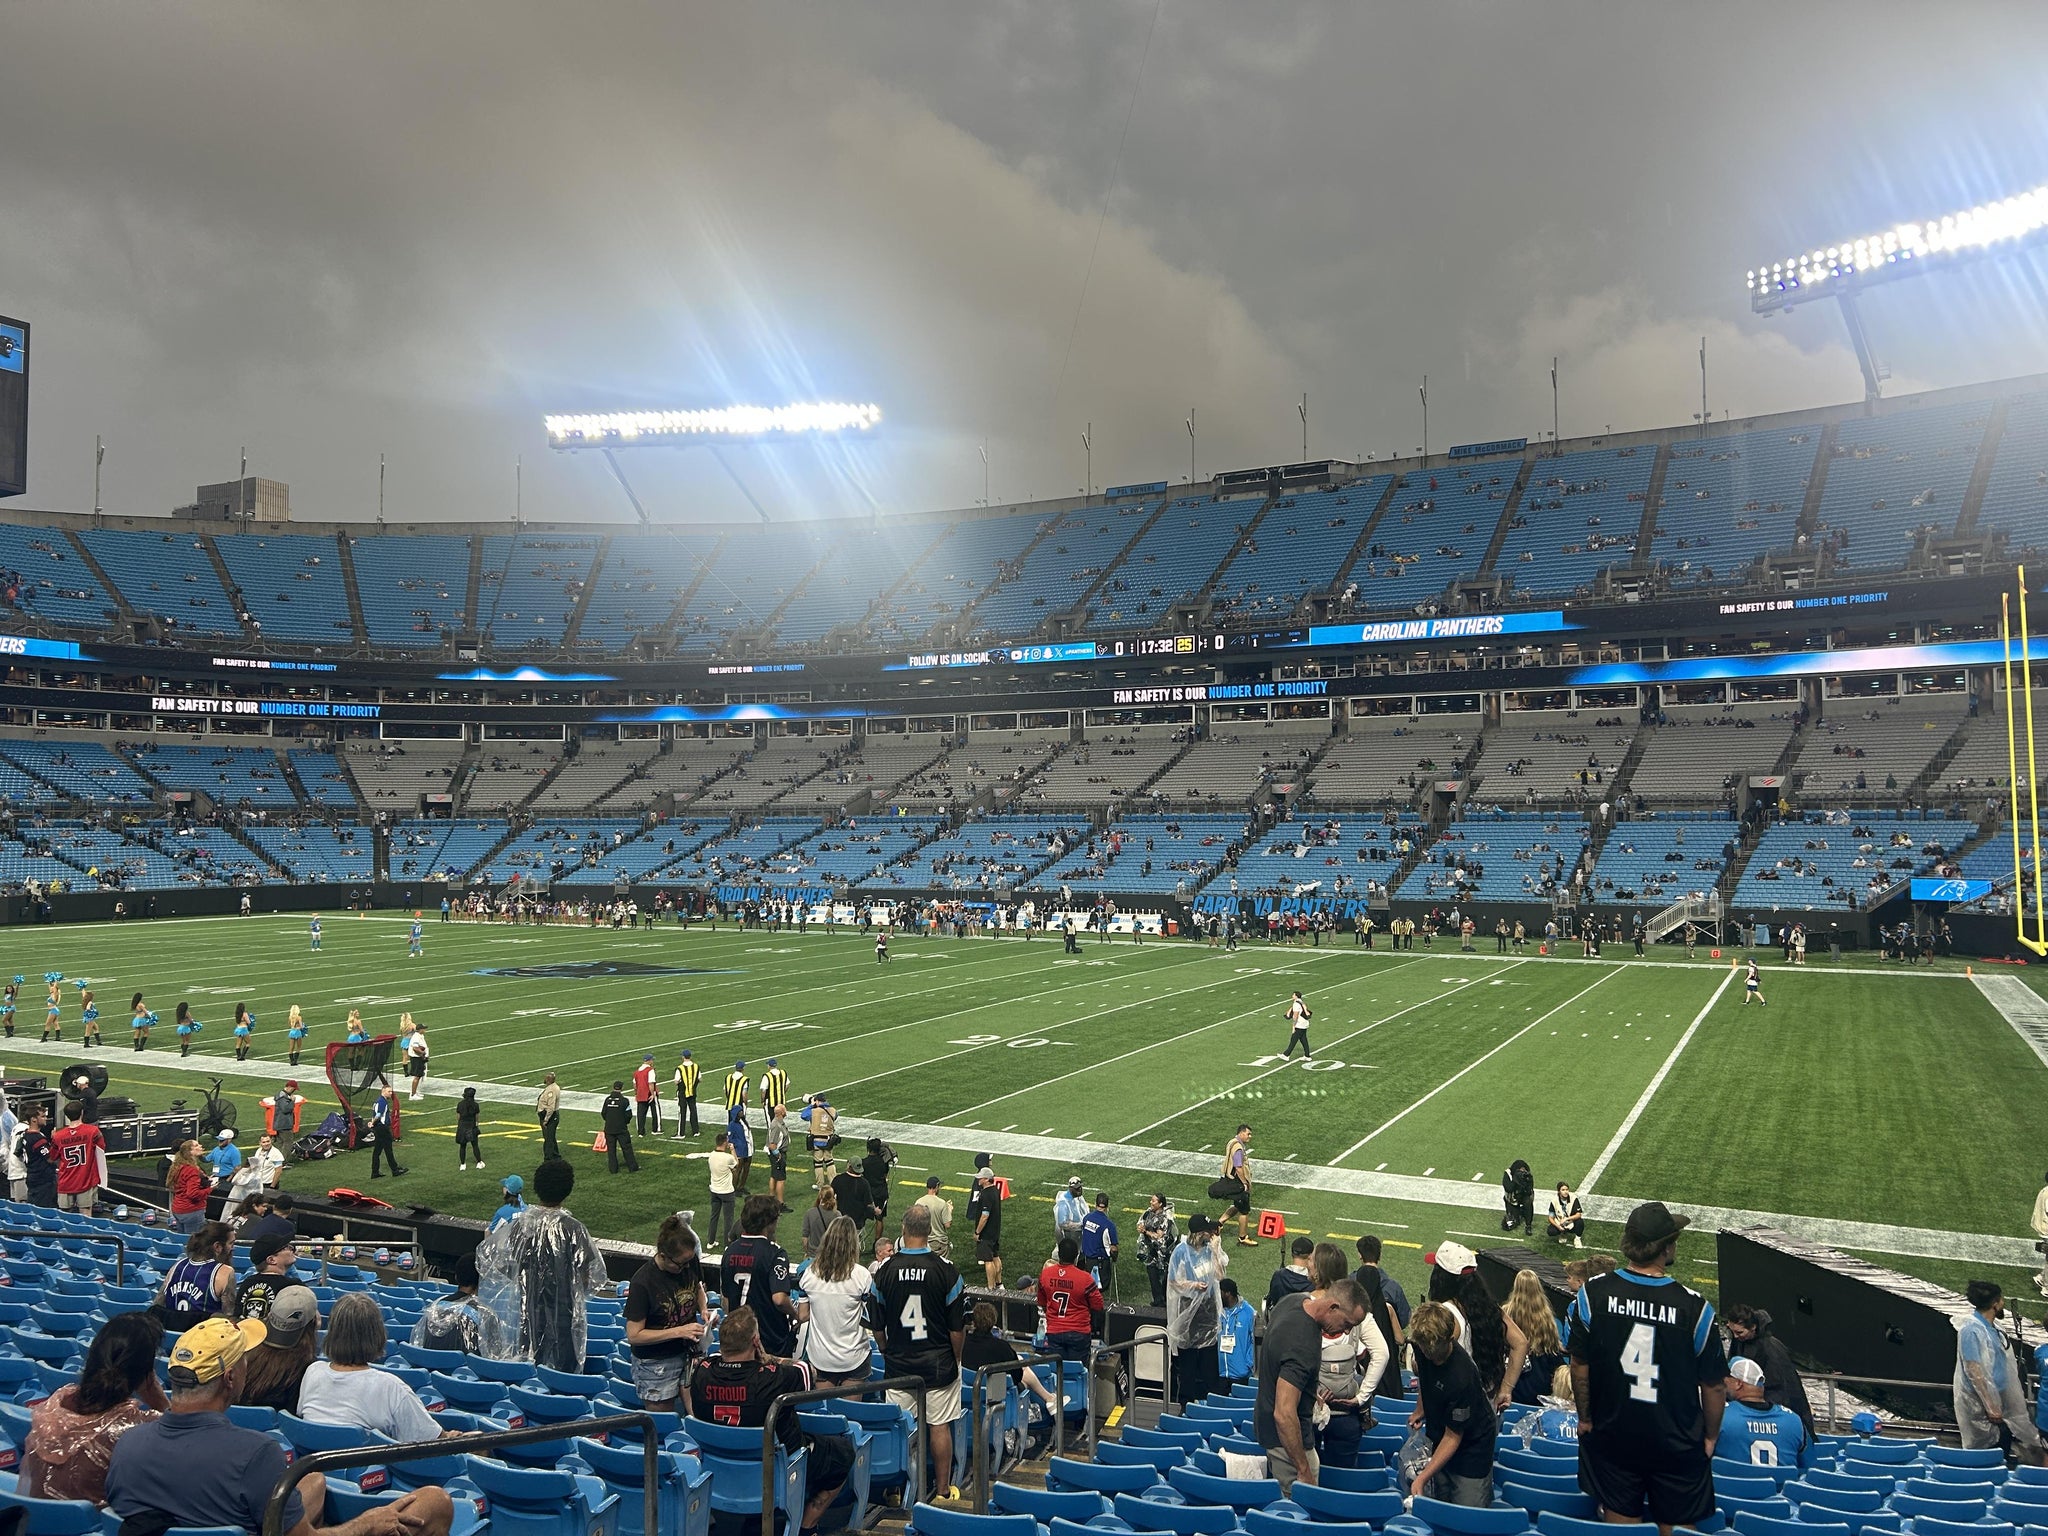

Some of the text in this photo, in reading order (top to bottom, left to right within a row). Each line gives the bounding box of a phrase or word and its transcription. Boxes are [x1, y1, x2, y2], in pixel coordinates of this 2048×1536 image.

[1454, 440, 1522, 456] MIKE McCORMACK
[1720, 592, 1888, 614] FAN SAFETY IS OUR NUMBER ONE PRIORITY
[1362, 616, 1505, 641] CAROLINA PANTHERS
[1115, 642, 1124, 656] 0
[1141, 639, 1174, 654] 17:32
[1177, 638, 1193, 652] 25
[1214, 634, 1224, 650] 0
[212, 658, 226, 666] FAN
[226, 658, 248, 668] SAFETY
[250, 660, 256, 668] IS
[257, 660, 270, 668] OUR
[270, 662, 296, 670] NUMBER
[310, 664, 338, 672] PRIORITY
[909, 652, 990, 667] FOLLOW US ON SOCIAL
[1114, 681, 1328, 704] FAN SAFETY IS OUR NUMBER ONE PRIORITY
[152, 697, 381, 718] FAN SAFETY IS OUR NUMBER ONE PRIORITY
[710, 886, 765, 904] CAROLIN
[1193, 896, 1274, 917] CAROLNA
[713, 1019, 804, 1032] 30
[946, 1034, 1051, 1048] 20
[63, 1144, 87, 1168] 51
[1263, 1216, 1276, 1236] G
[730, 1254, 754, 1267] STROUD
[898, 1268, 927, 1282] KASAY
[170, 1280, 204, 1301] JOHNSON
[248, 1282, 267, 1294] BLOOD
[734, 1272, 751, 1306] 7
[1049, 1279, 1074, 1290] STROUD
[1052, 1292, 1070, 1318] 7
[1608, 1296, 1677, 1325] McMILLAN
[900, 1294, 928, 1341] 4
[1620, 1322, 1660, 1404] 4
[706, 1385, 746, 1402] STROUD
[714, 1405, 741, 1427] 7
[1560, 1425, 1578, 1439] YOU
[1747, 1421, 1778, 1435] YOUNG
[362, 1474, 385, 1487] Coca-Cola
